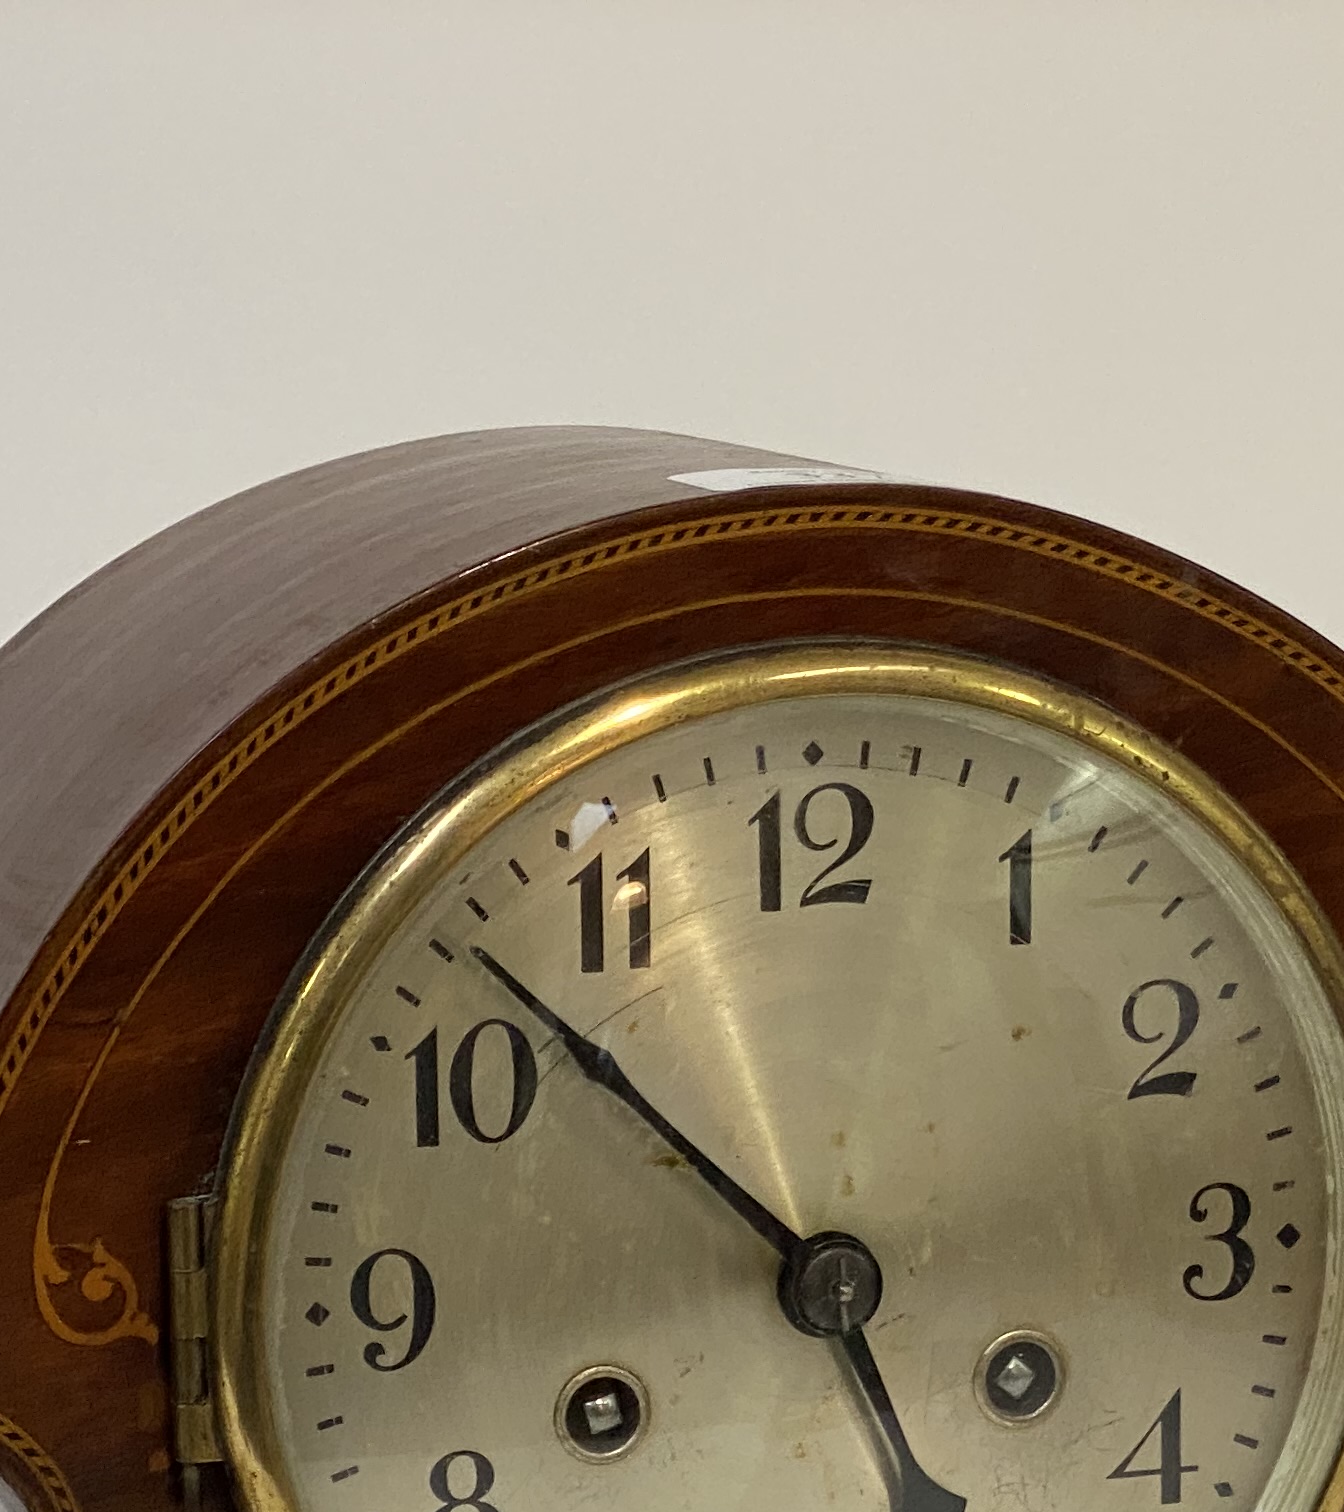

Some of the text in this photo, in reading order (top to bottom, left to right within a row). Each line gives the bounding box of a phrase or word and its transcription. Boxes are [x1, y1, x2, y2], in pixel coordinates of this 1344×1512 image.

[747, 782, 875, 911] 12
[999, 829, 1032, 944] 1
[568, 845, 651, 972] 11
[404, 1018, 538, 1146] 10
[1120, 979, 1199, 1099] 2
[1182, 1183, 1253, 1300] 3
[350, 1249, 436, 1373] 9
[1106, 1388, 1198, 1505] 4
